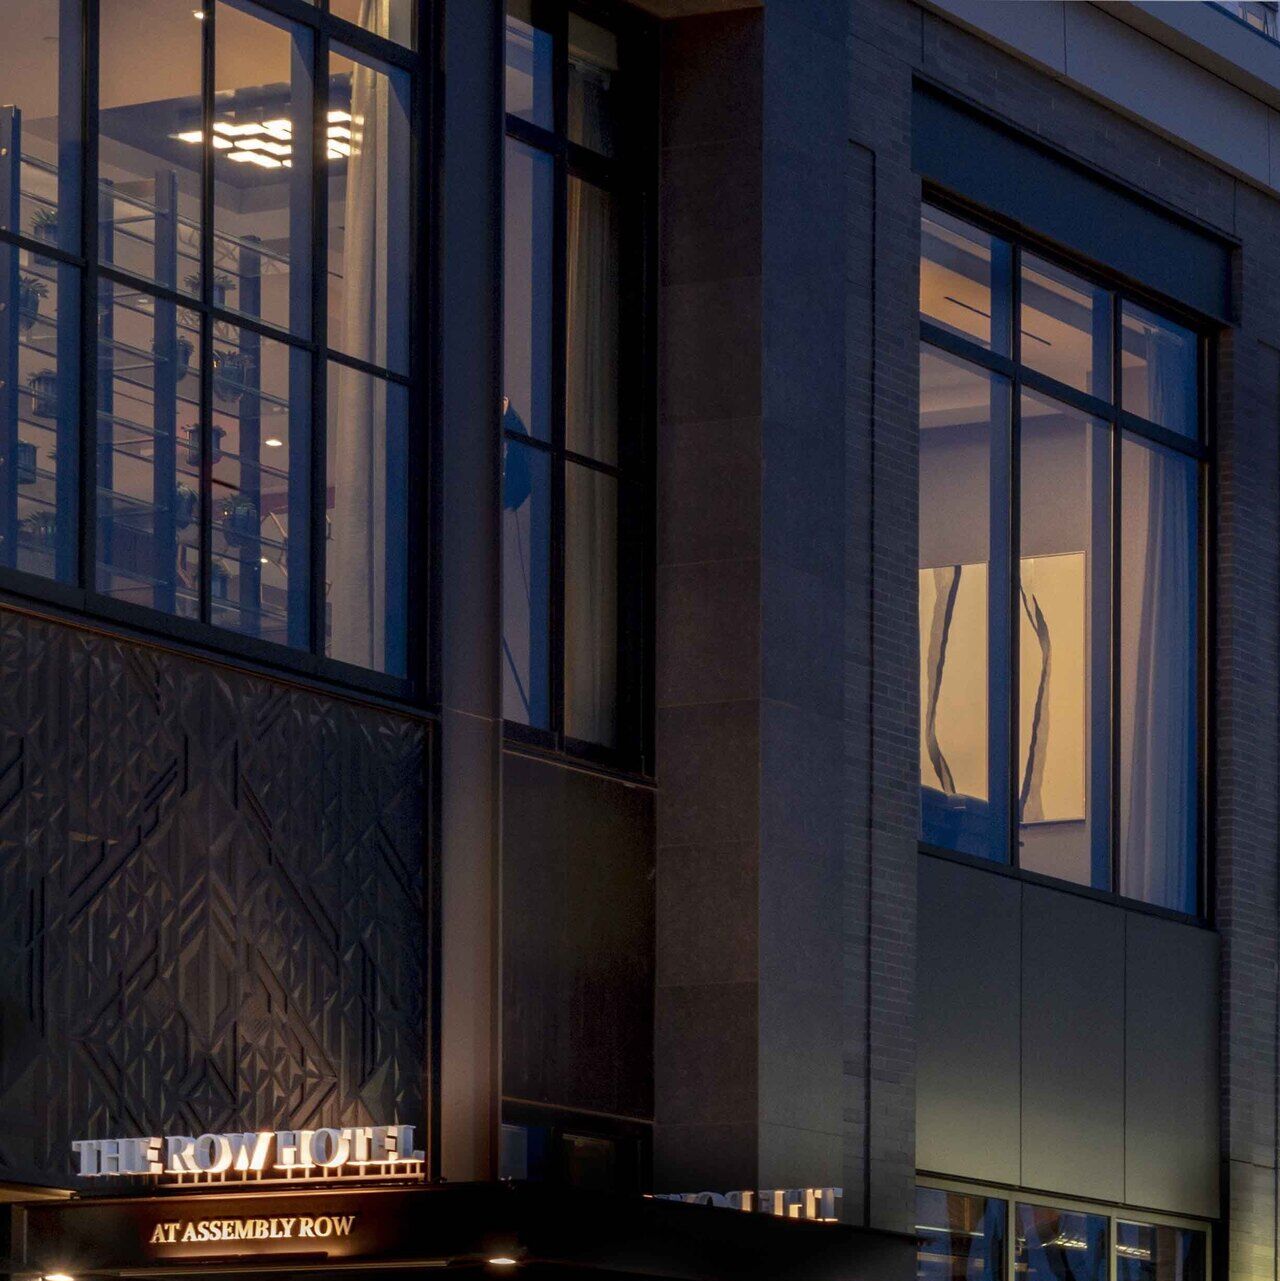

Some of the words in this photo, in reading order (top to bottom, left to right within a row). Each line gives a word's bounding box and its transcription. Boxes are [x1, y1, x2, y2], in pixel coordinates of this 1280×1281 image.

[72, 1137, 163, 1176] THE
[165, 1132, 275, 1174] ROW
[276, 1125, 425, 1168] HOTEL
[150, 1223, 180, 1243] AT
[181, 1218, 300, 1242] ASSEMBLY
[301, 1216, 355, 1237] ROW
